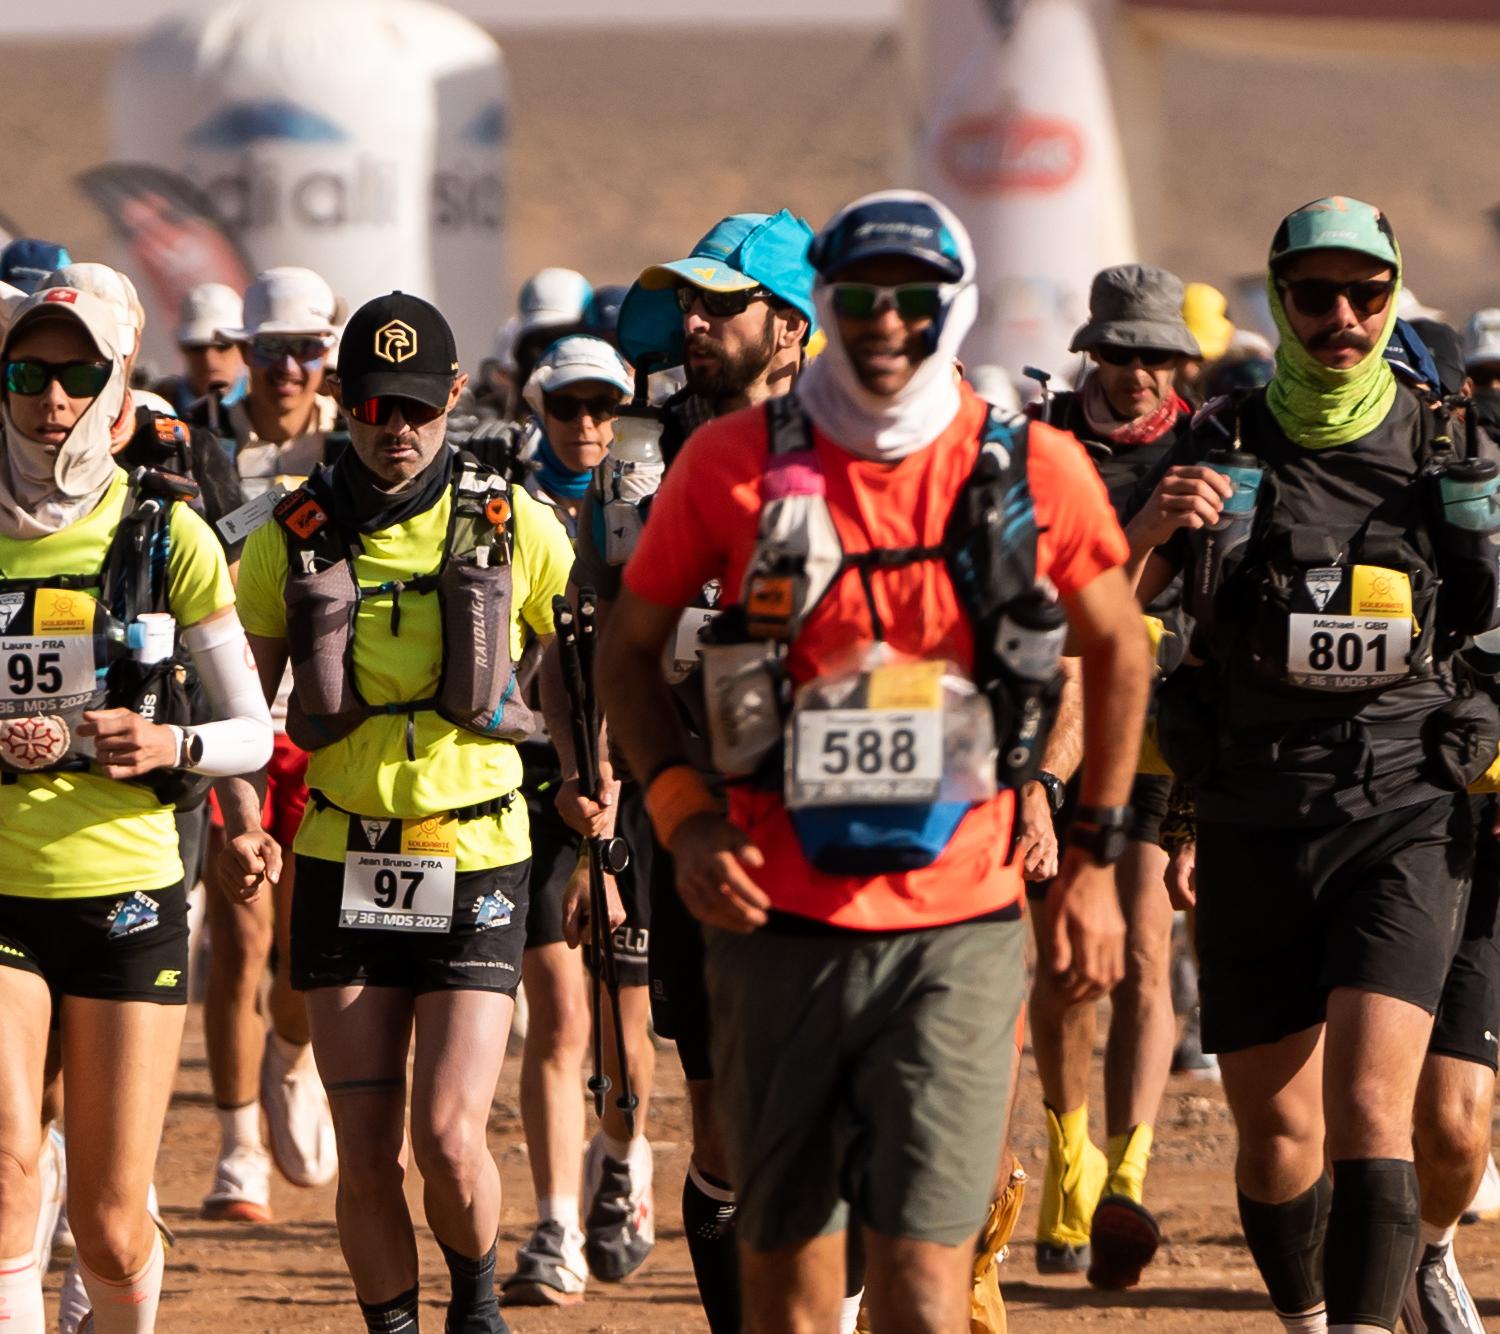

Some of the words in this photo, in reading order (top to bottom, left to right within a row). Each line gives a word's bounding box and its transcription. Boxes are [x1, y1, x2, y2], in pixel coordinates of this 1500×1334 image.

[1313, 619, 1355, 629] Michael
[2, 641, 32, 650] Laure
[42, 640, 65, 649] FRA
[1308, 631, 1387, 672] 801
[7, 653, 63, 695] 95
[23, 699, 57, 712] MDS
[60, 692, 93, 709] 2022
[822, 727, 917, 775] 588
[358, 857, 380, 866] Jean
[383, 858, 412, 868] Bruno
[421, 860, 443, 869] FRA
[374, 869, 424, 910] 97
[359, 913, 376, 924] 36
[383, 914, 413, 926] MDS
[415, 916, 448, 928] 2022
